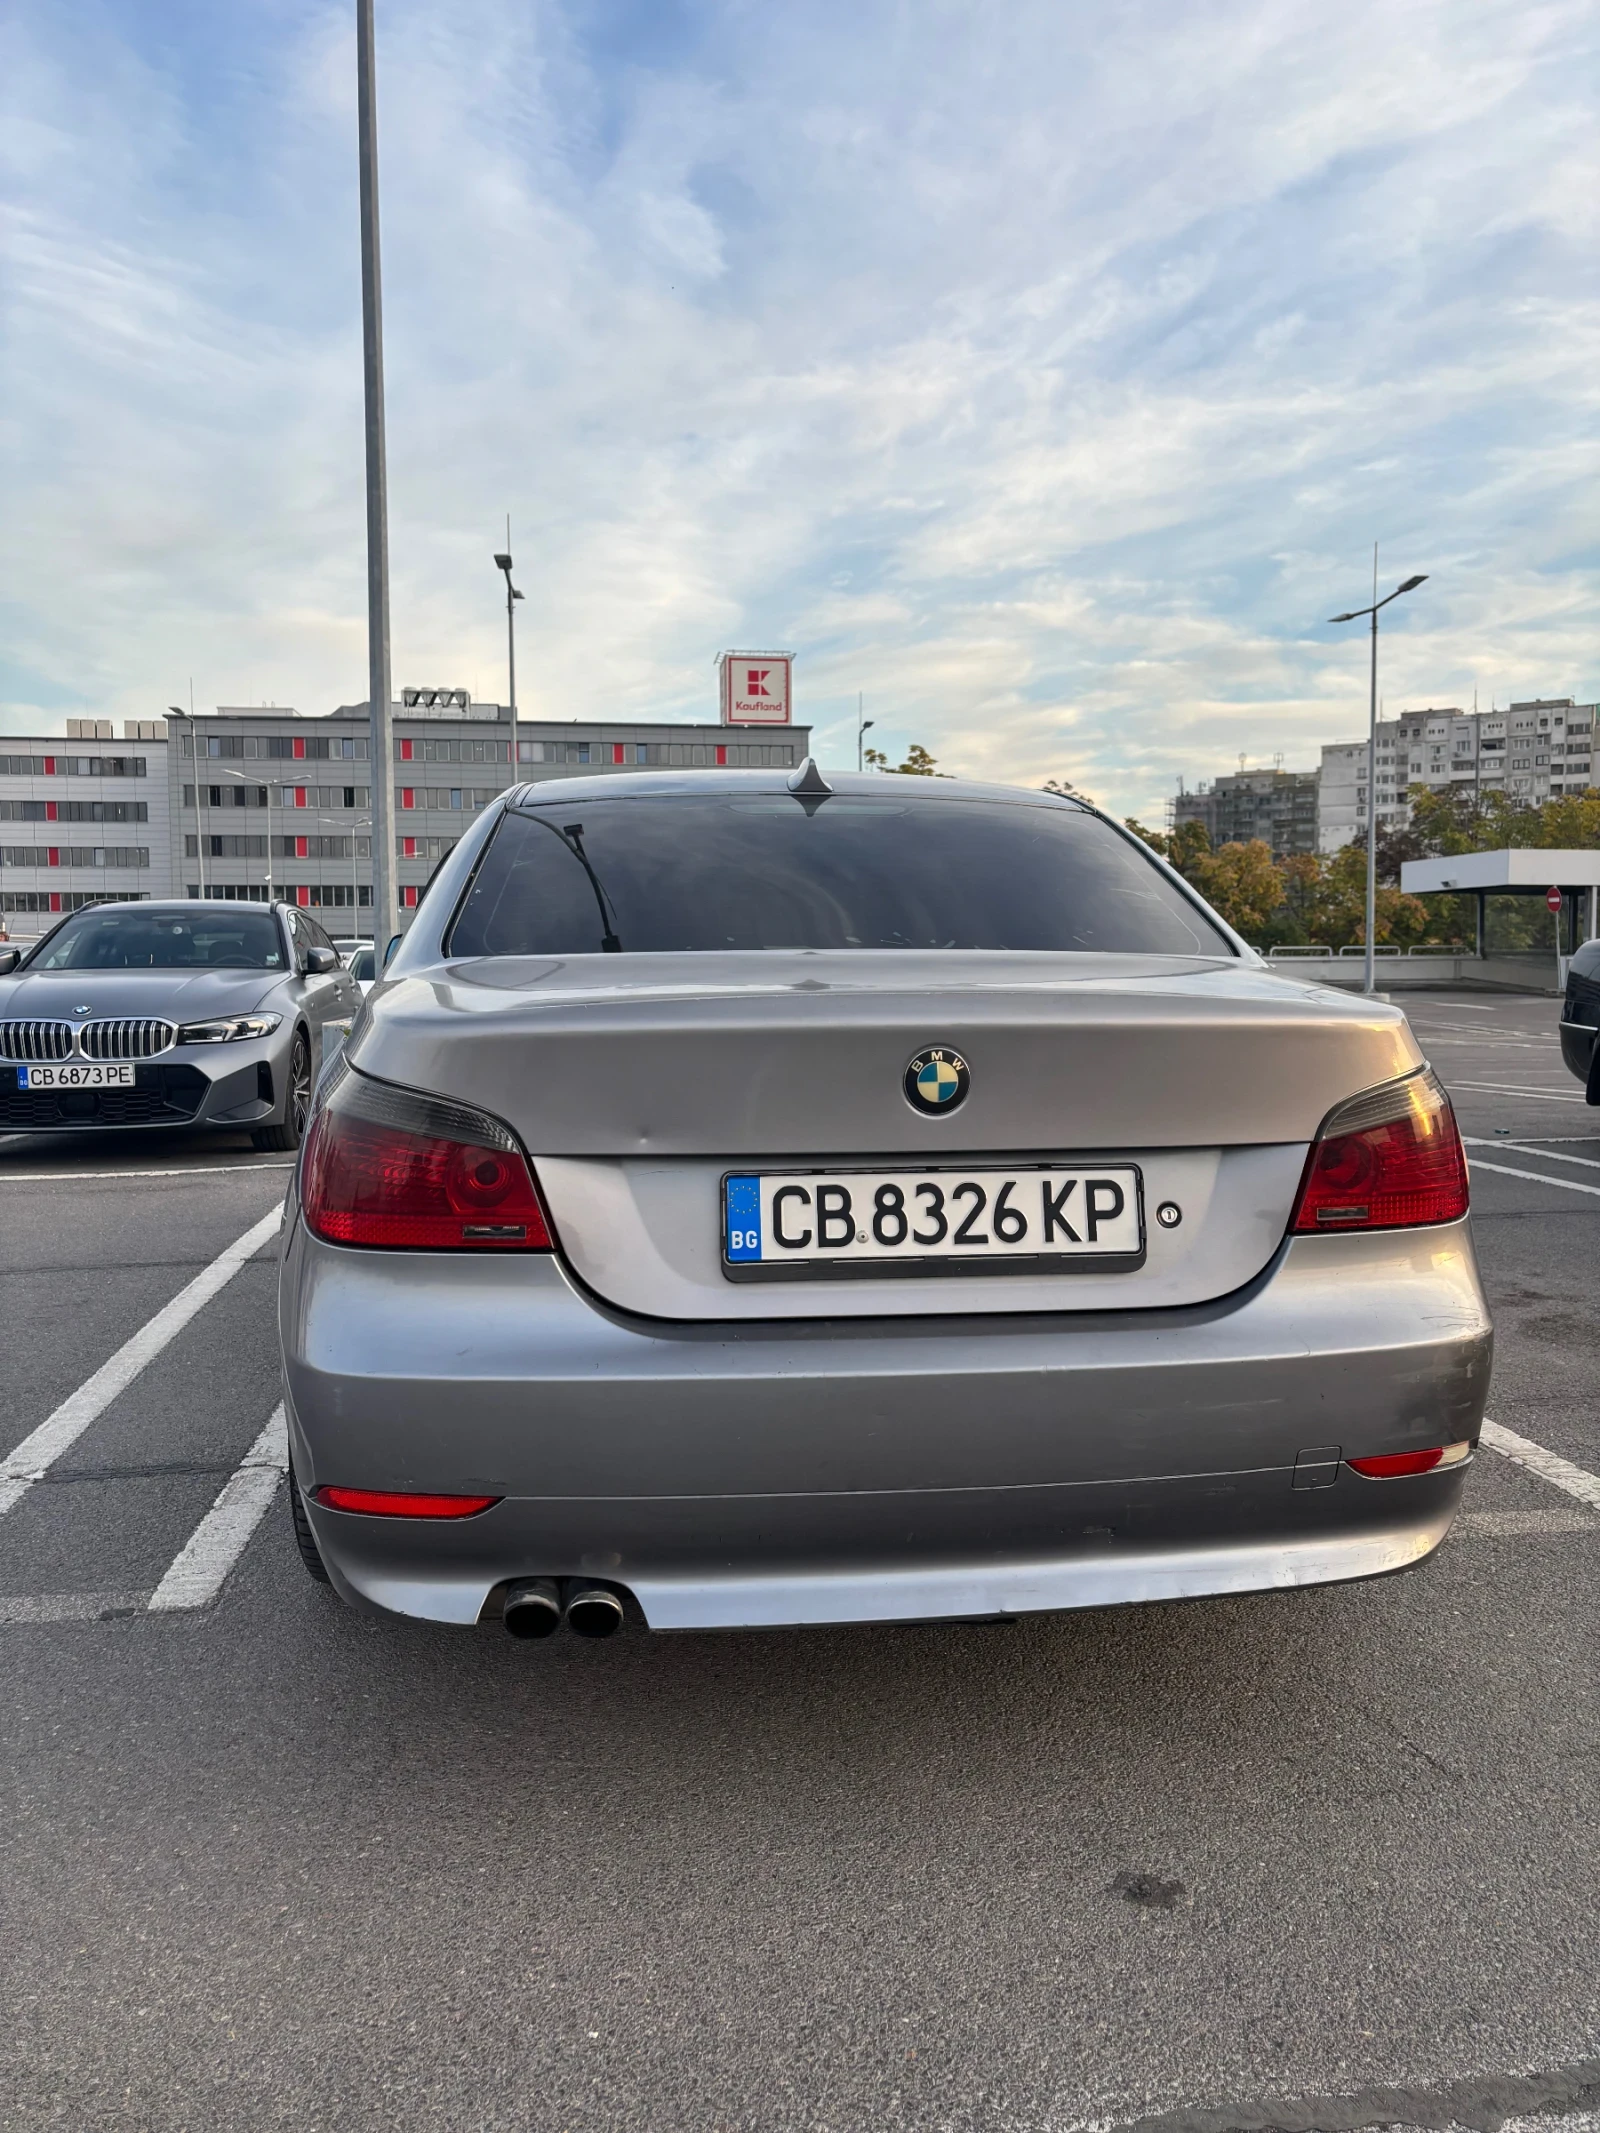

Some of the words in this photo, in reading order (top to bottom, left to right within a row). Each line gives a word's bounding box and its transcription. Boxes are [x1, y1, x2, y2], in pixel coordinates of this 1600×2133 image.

[747, 670, 771, 695] K
[736, 701, 782, 711] Kaufland
[911, 1051, 964, 1072] BMW
[31, 1068, 54, 1085] CB
[59, 1067, 103, 1085] 6873
[106, 1066, 130, 1084] PE
[773, 1184, 856, 1249] CB
[872, 1181, 1028, 1246] 8326
[1042, 1179, 1124, 1243] KP
[731, 1230, 757, 1249] BG
